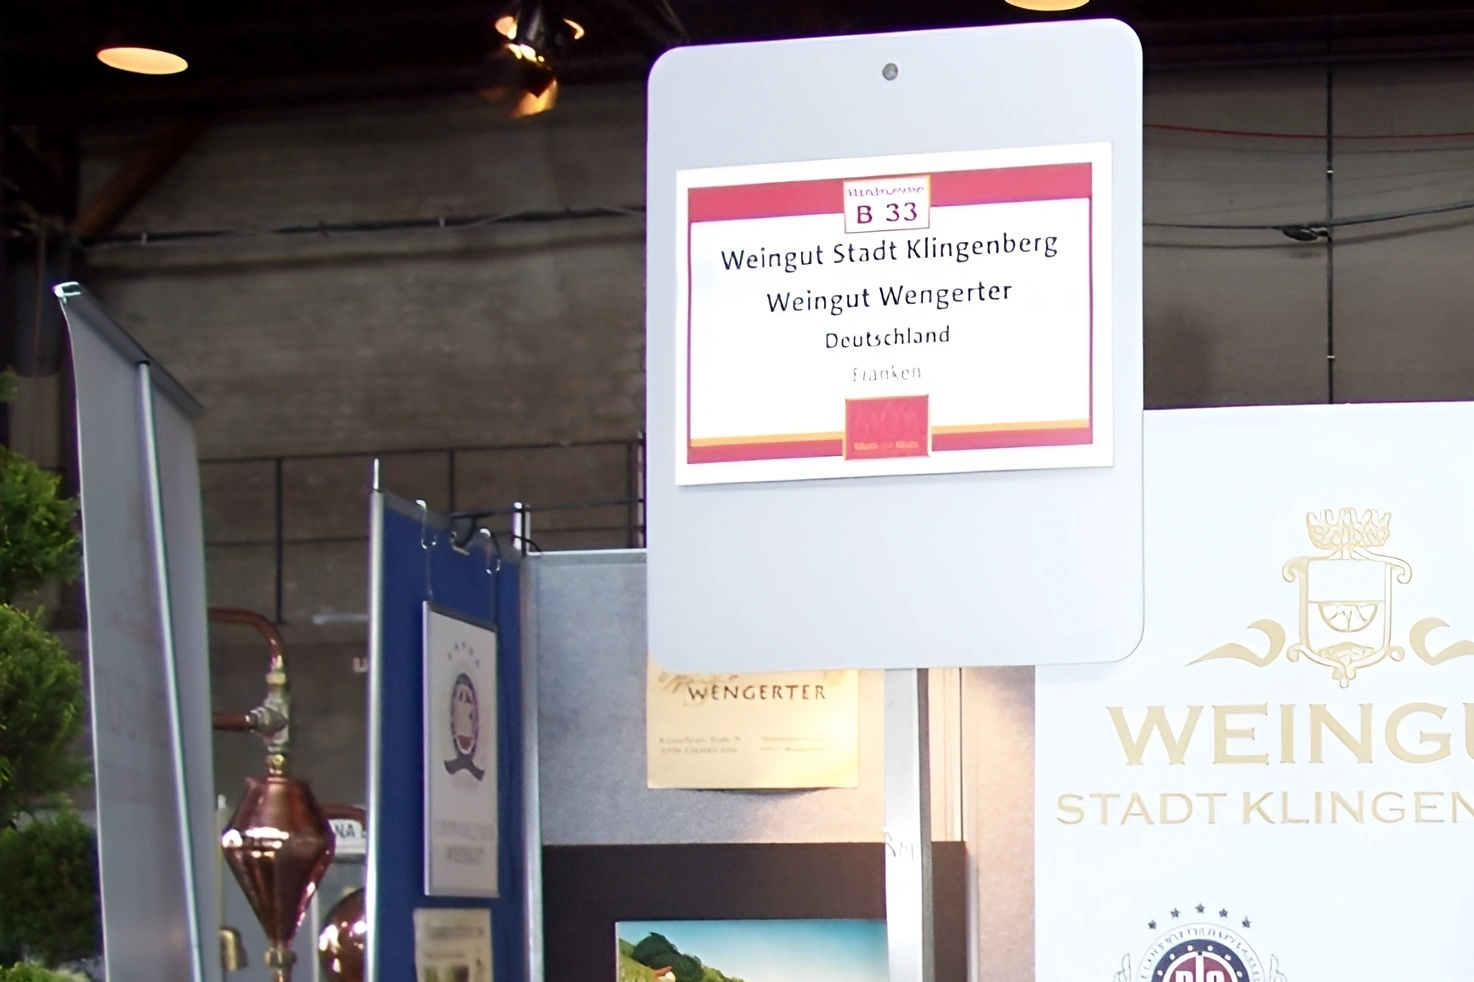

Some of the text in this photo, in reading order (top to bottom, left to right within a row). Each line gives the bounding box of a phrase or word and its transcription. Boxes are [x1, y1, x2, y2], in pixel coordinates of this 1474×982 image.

[857, 202, 917, 224] B 33
[721, 232, 1059, 273] Weingut Stadt Klingenberg
[767, 281, 1012, 317] Weingut Wengerter
[825, 325, 950, 349] Deutschland
[852, 364, 921, 382] Franken
[688, 684, 825, 700] WENGERTER
[1056, 792, 1228, 825] STADT
